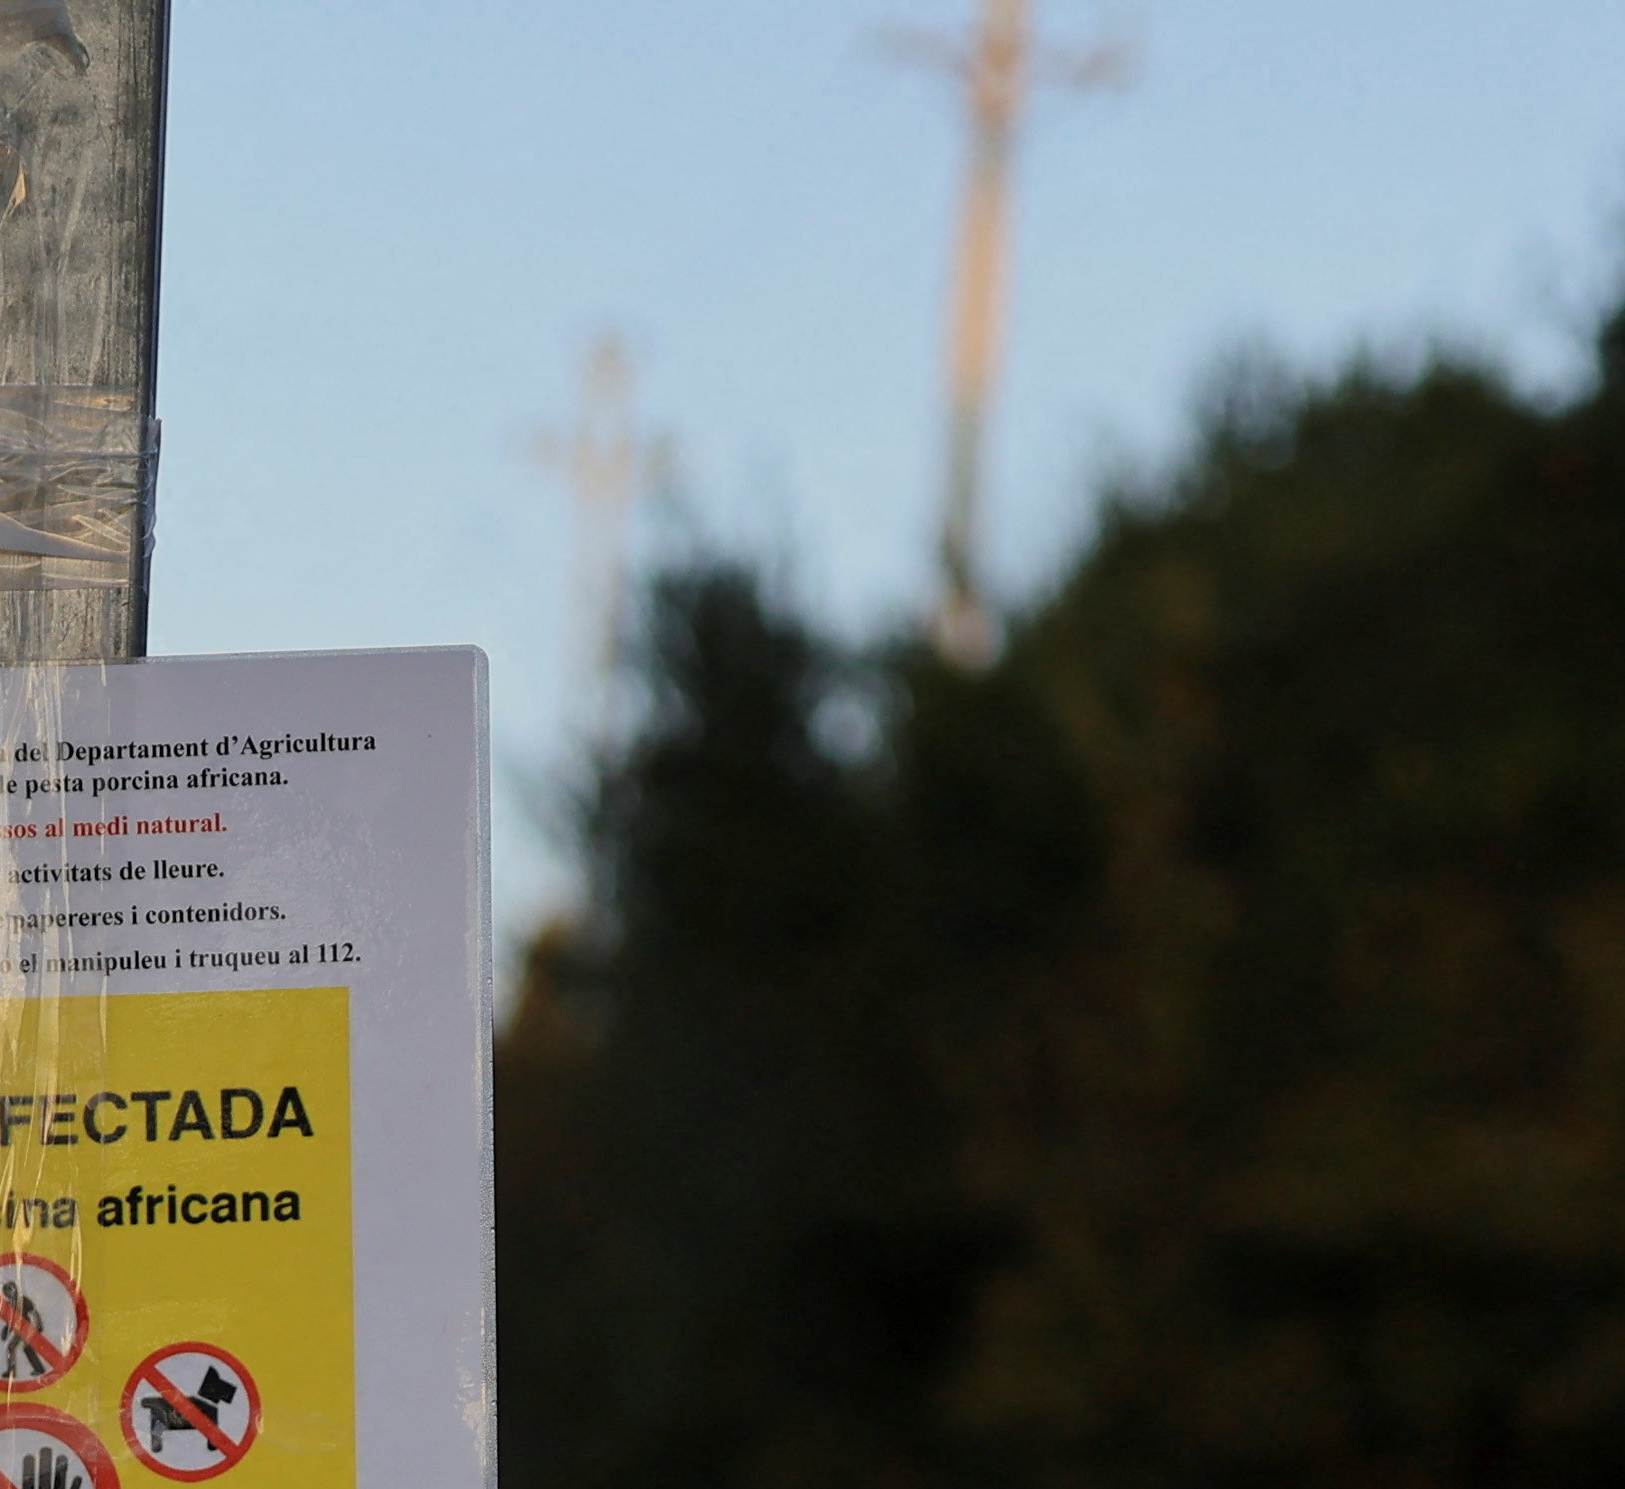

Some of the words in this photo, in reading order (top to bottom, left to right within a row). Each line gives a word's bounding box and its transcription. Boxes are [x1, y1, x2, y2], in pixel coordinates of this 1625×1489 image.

[14, 740, 48, 762] del
[55, 738, 209, 766] Departament
[25, 774, 83, 798] pesta
[92, 770, 178, 797] porcina
[186, 766, 288, 789] africana.
[44, 817, 63, 837] al
[73, 814, 127, 837] medi
[136, 812, 227, 835] natural.
[8, 861, 111, 884] activitats
[119, 859, 145, 880] de
[153, 857, 224, 880] lleure.
[11, 906, 123, 934] papereres
[131, 904, 137, 925] i
[145, 899, 286, 925] contenidors.
[19, 952, 37, 973] el
[47, 949, 167, 977] manipuleu
[174, 948, 181, 968] i
[189, 949, 280, 974] truqueu
[288, 943, 310, 965] al
[317, 942, 362, 964] 112.
[96, 1183, 301, 1226] africana
